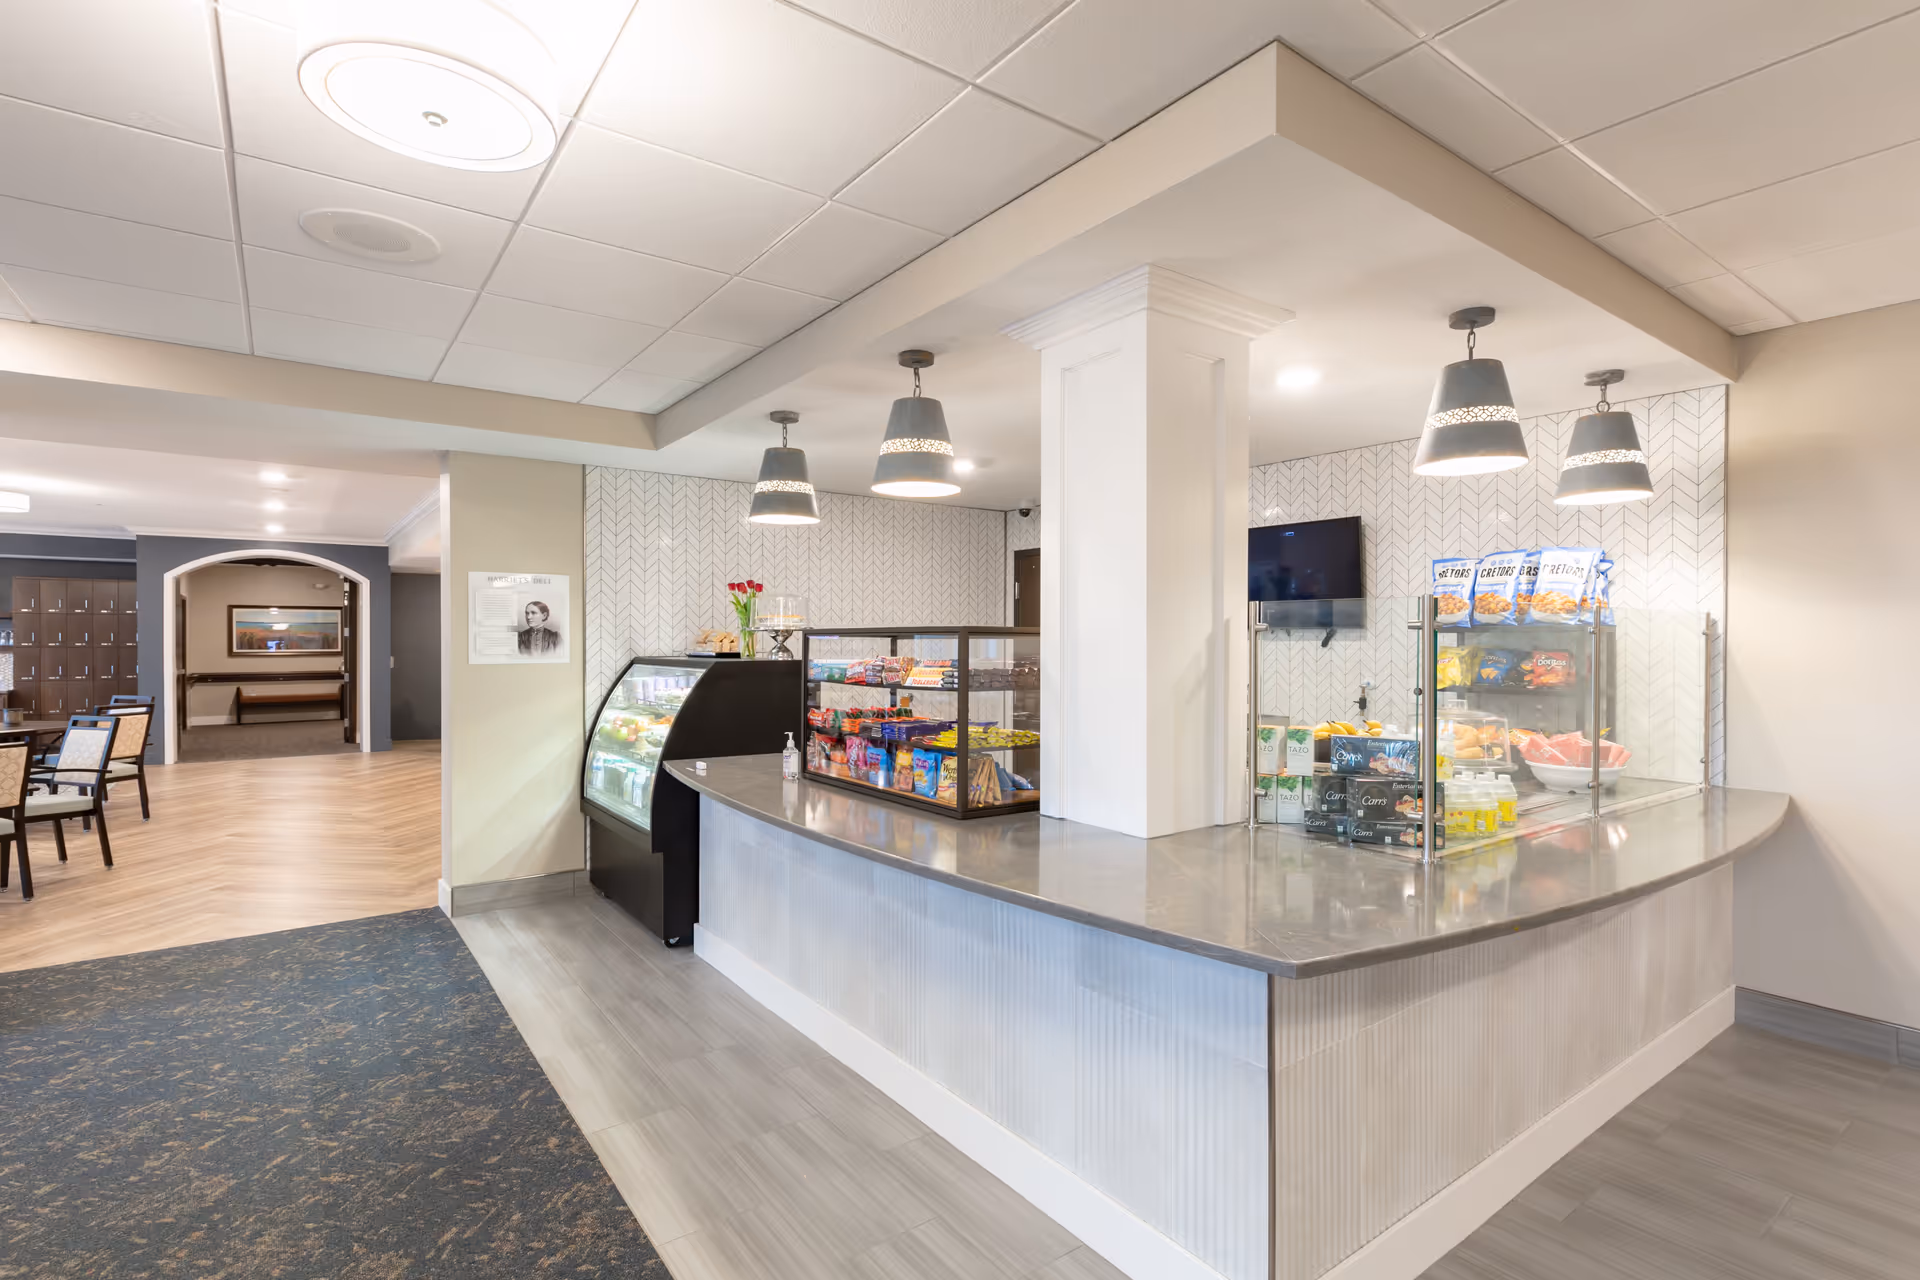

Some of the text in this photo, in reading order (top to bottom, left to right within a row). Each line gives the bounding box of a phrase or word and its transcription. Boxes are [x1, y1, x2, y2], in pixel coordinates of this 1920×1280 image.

[1480, 566, 1516, 578] CRETORS
[533, 577, 551, 585] DELI
[1288, 746, 1309, 754] TAZO
